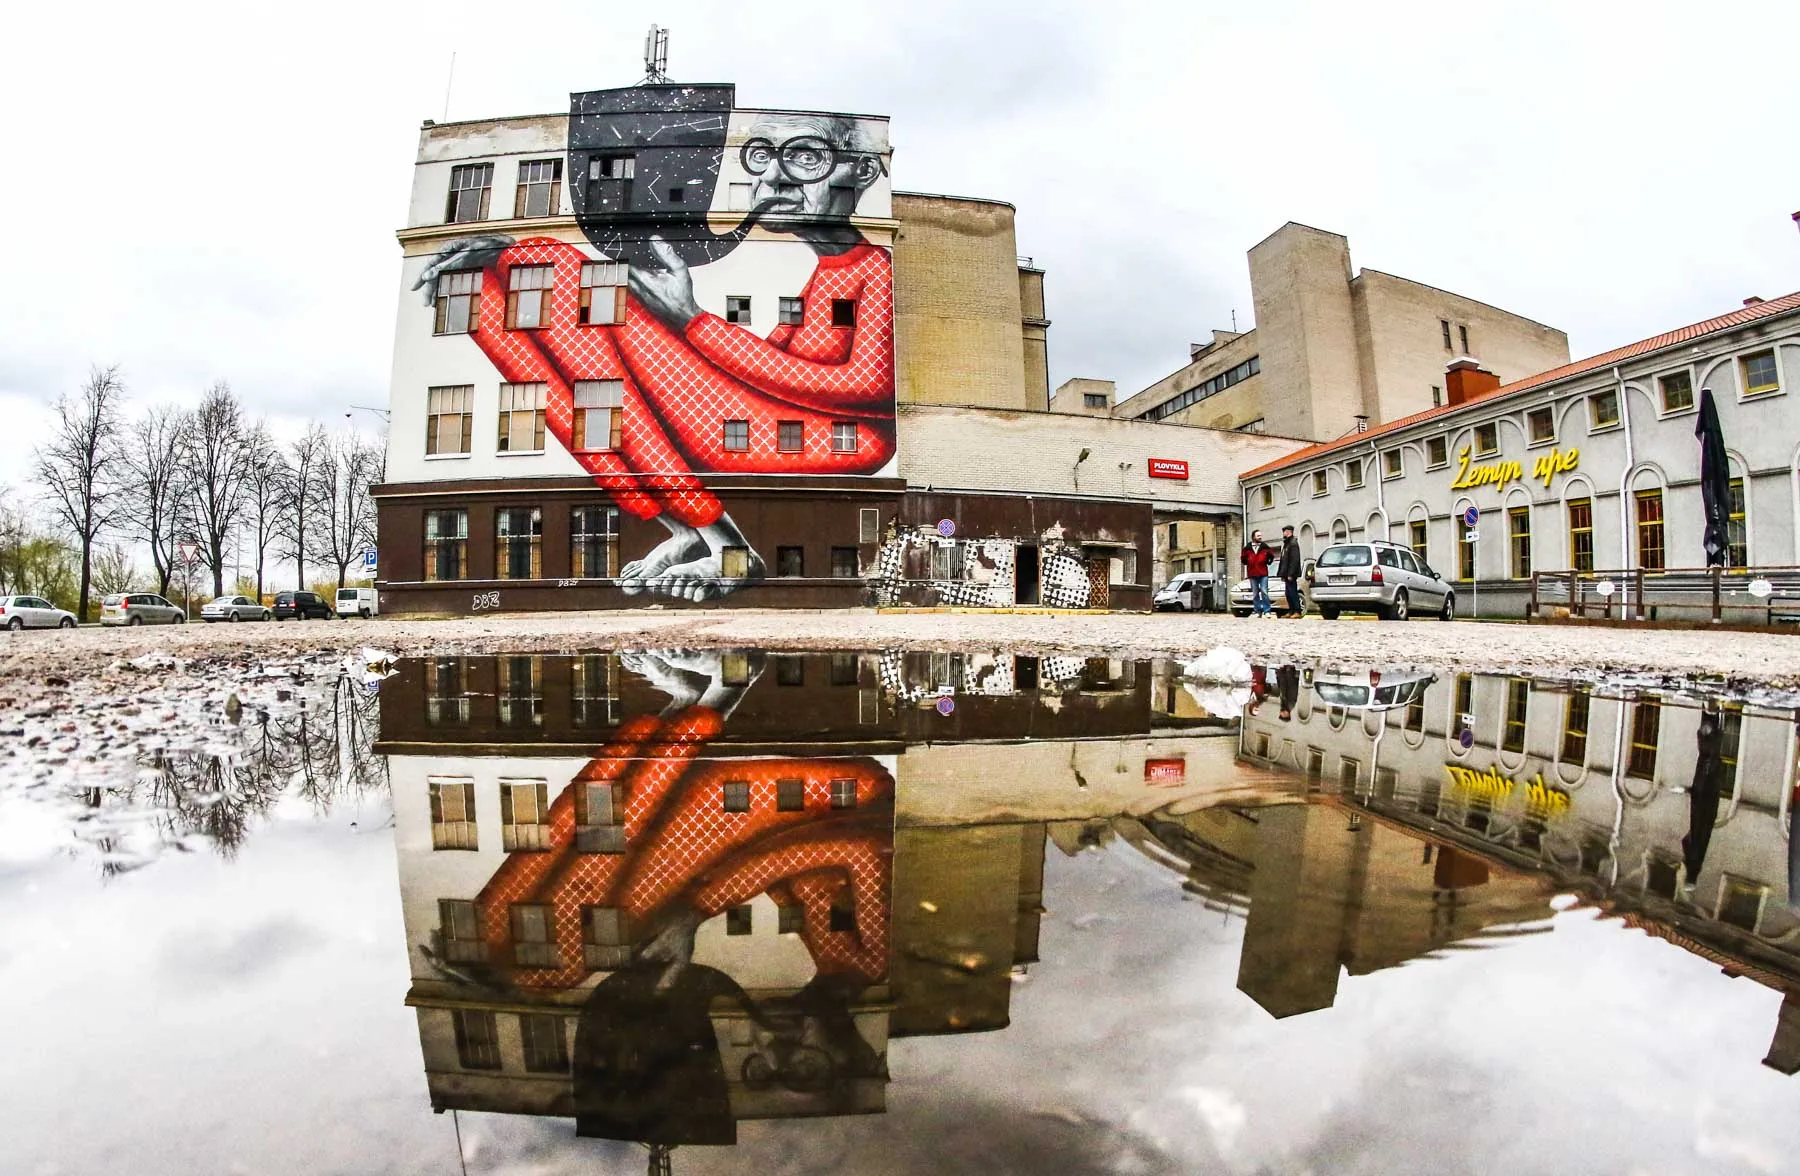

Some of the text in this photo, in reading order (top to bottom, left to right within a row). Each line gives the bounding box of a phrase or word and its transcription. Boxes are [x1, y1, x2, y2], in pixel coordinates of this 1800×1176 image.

[1153, 462, 1185, 471] PLOVYKLA
[1451, 444, 1580, 492] Žemyn upe
